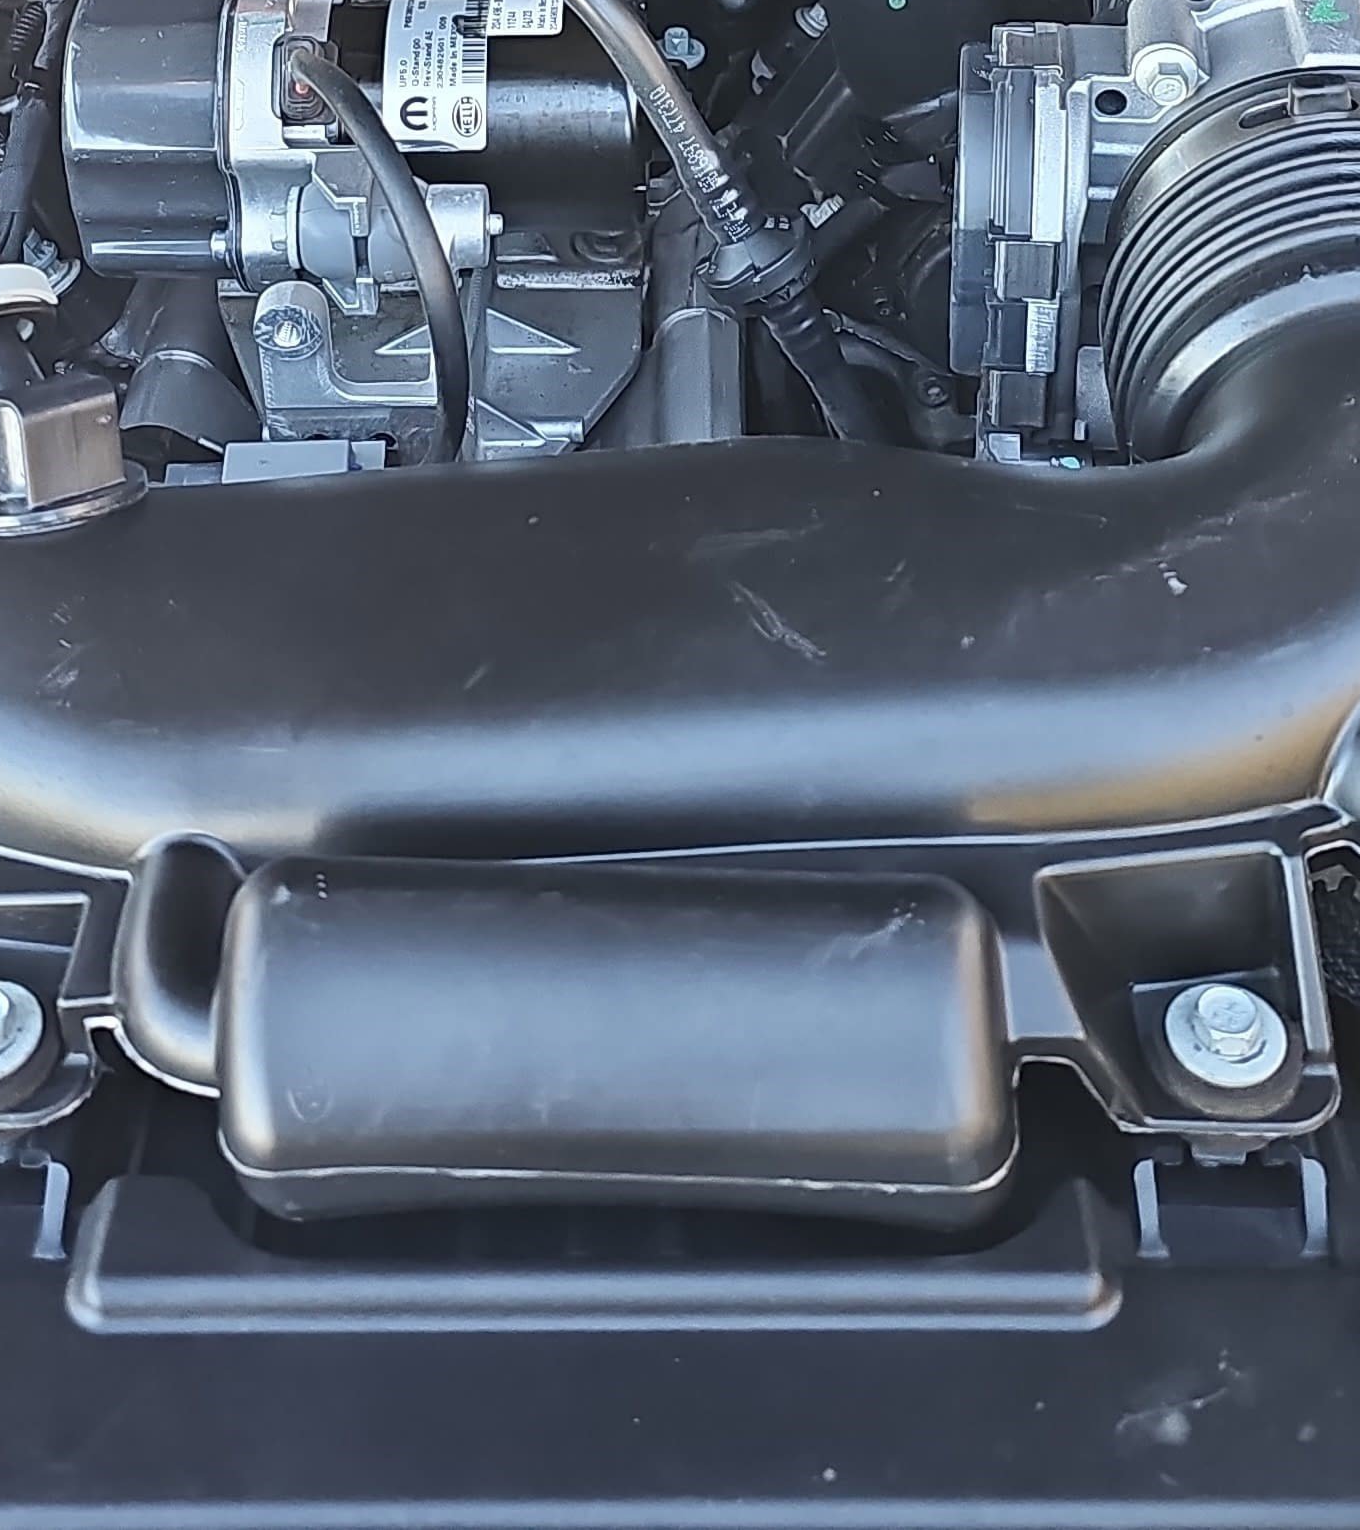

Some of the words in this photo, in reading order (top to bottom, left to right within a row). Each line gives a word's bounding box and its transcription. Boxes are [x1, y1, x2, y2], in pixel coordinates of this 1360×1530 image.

[399, 59, 408, 88] UP5.0
[423, 42, 433, 87] Rev-Stand
[448, 61, 457, 87] Made
[461, 96, 473, 135] HELLA
